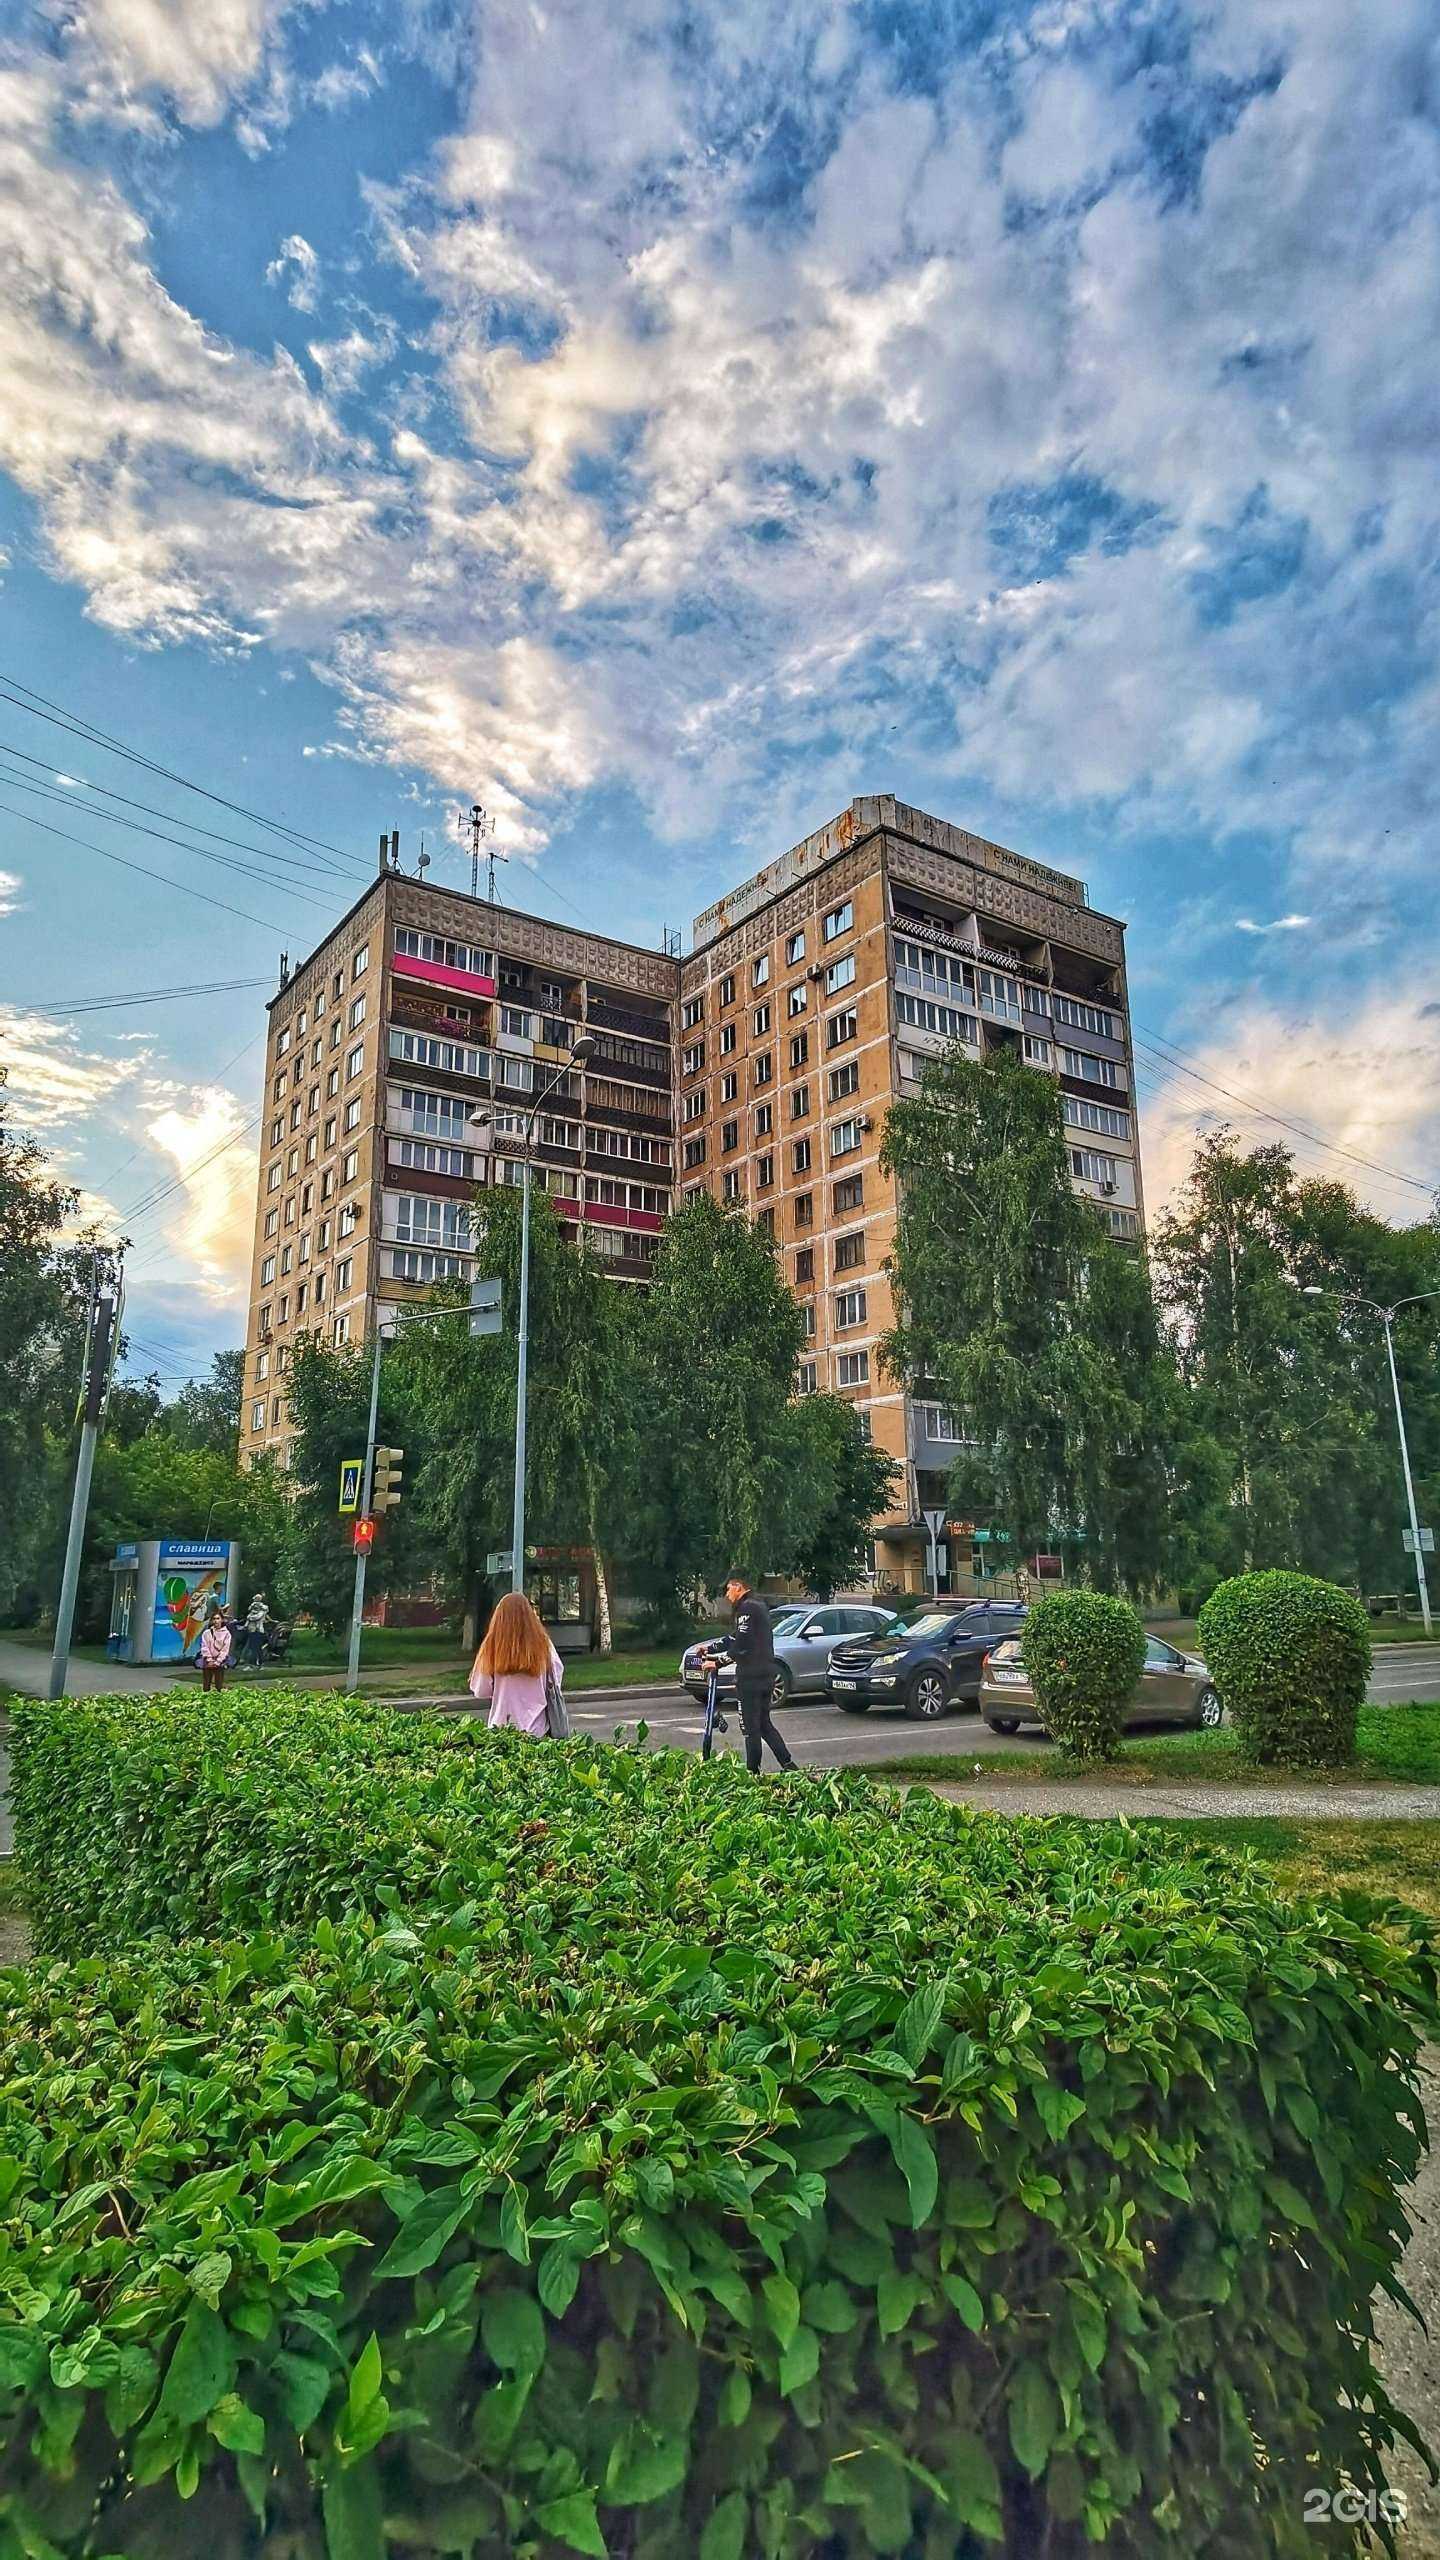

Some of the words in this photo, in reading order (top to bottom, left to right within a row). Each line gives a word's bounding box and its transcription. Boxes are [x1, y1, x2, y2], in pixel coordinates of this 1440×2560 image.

[993, 849, 1001, 859] С
[1002, 853, 1027, 872] НАМИ
[168, 1544, 221, 1554] славица
